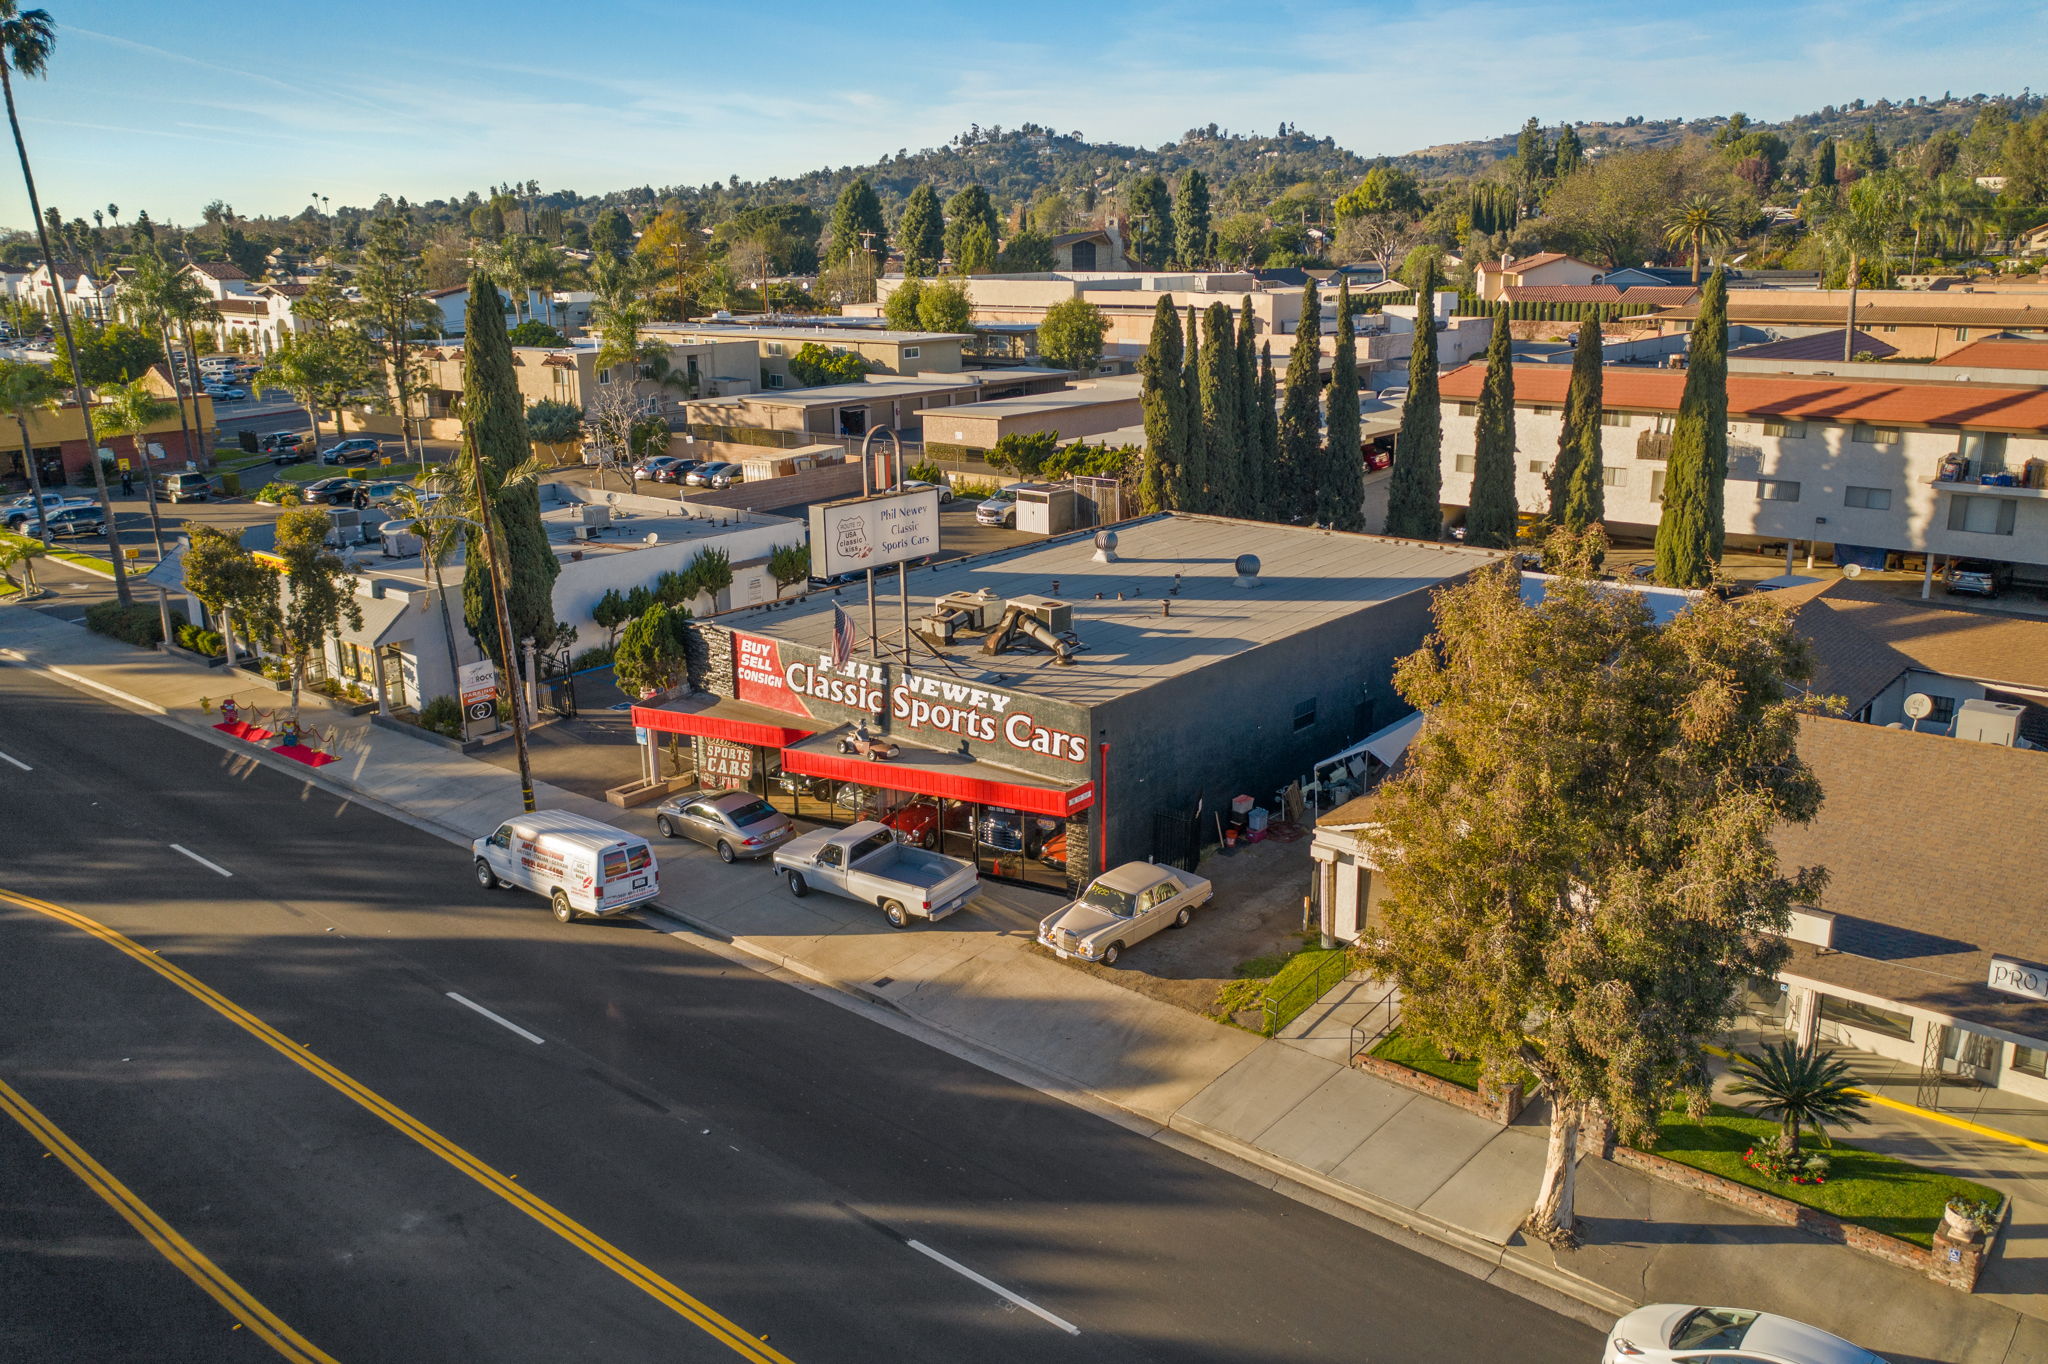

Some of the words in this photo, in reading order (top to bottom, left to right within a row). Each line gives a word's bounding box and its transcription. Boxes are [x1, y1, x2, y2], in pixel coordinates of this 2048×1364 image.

[880, 508, 897, 521] Phil
[900, 505, 928, 517] Newey
[845, 531, 857, 539] USA
[891, 521, 920, 536] Classic
[840, 537, 863, 547] classic
[882, 539, 909, 554] Sports
[911, 534, 930, 546] Cars
[741, 639, 771, 657] BUY
[740, 653, 773, 672] SELL
[738, 667, 783, 689] CONSIGN
[463, 687, 494, 698] PARKING
[901, 673, 1011, 713] NEWEY
[785, 662, 884, 713] Classic
[893, 687, 996, 742] Sports
[1005, 714, 1087, 762] Cars
[707, 745, 751, 762] SPORTS
[707, 757, 751, 777] CARS
[1993, 965, 2038, 991] PRO
